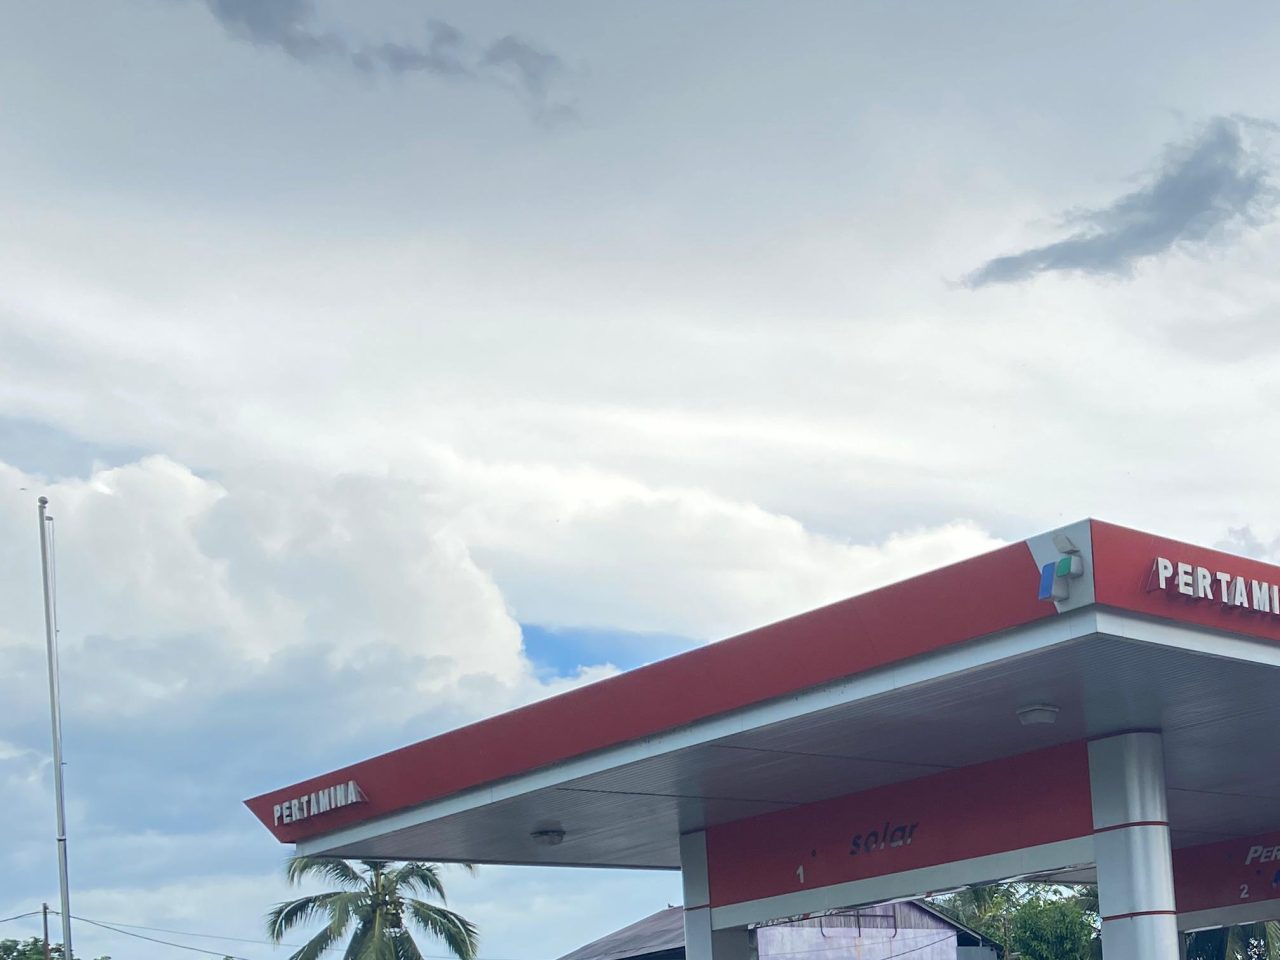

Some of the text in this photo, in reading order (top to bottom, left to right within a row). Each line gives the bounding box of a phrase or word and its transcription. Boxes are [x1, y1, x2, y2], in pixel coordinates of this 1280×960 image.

[273, 780, 358, 827] PERTAMINA
[849, 821, 919, 855] solar
[796, 864, 805, 884] 1
[1239, 883, 1249, 899] 2
